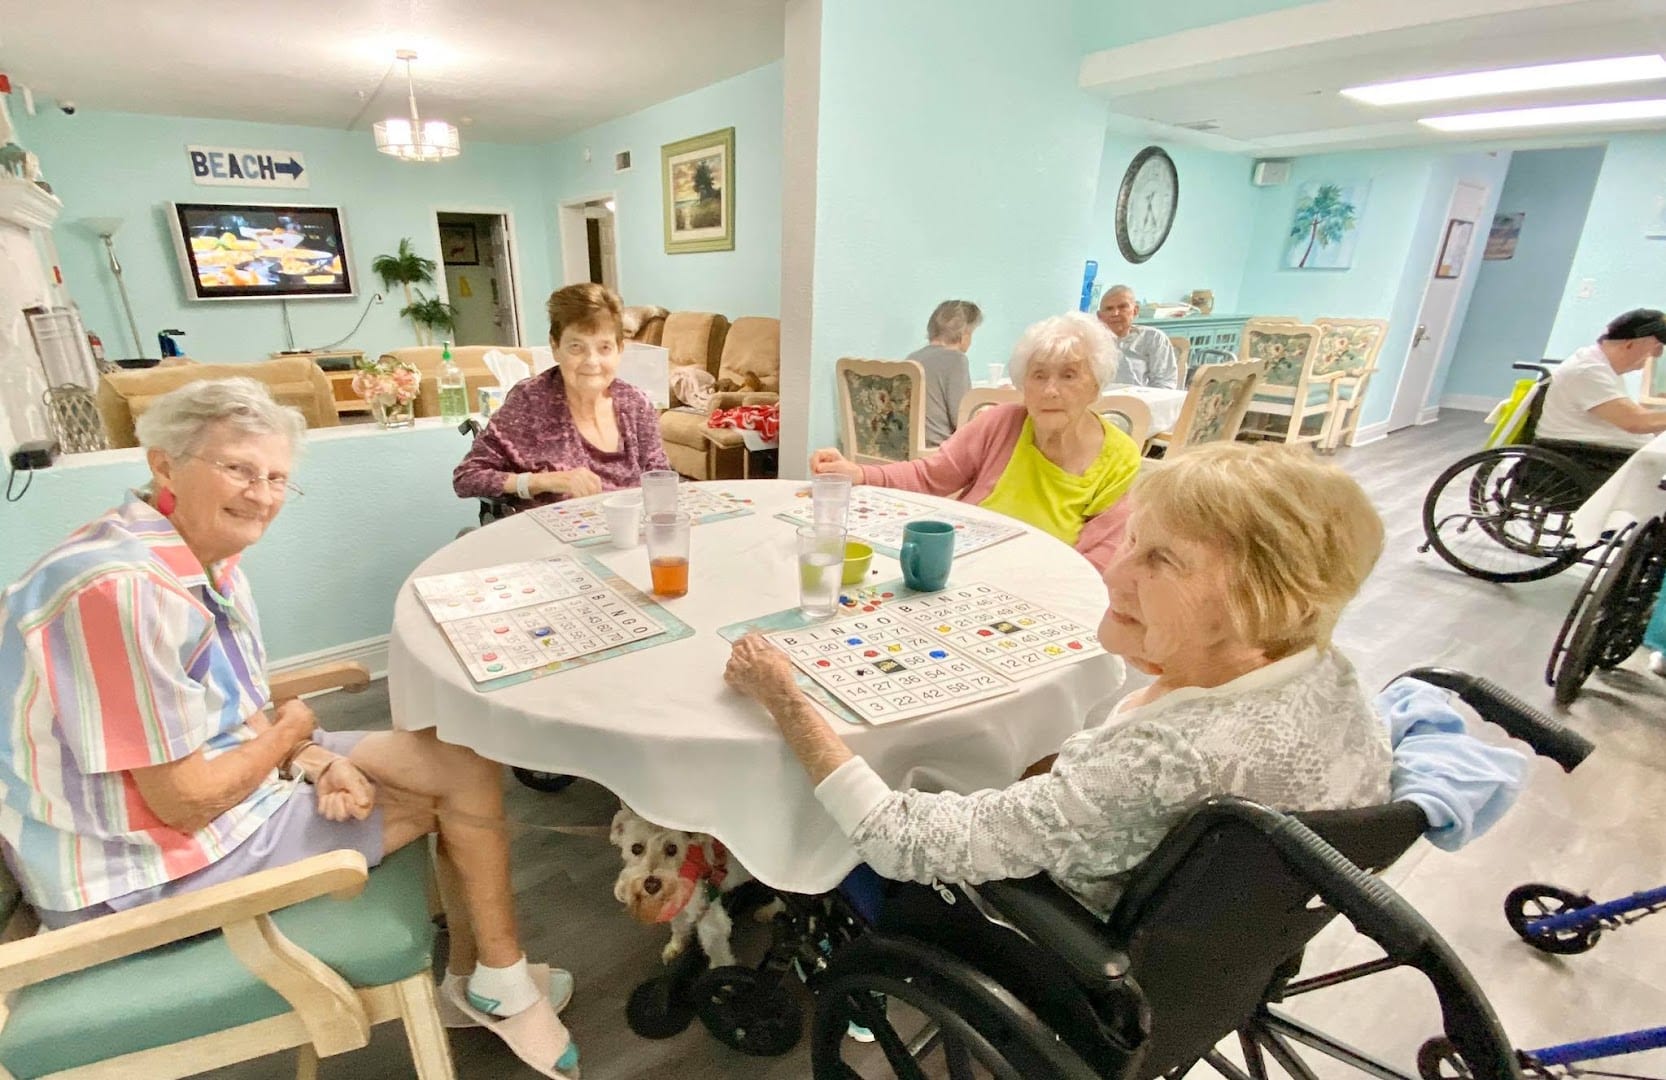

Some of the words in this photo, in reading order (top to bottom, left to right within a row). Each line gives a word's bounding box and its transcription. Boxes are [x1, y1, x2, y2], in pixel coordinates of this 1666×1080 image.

[190, 151, 275, 180] BEACH
[819, 643, 839, 652] 30
[891, 626, 910, 635] 71
[836, 655, 853, 664] 17
[907, 638, 928, 647] 74
[956, 635, 968, 643] 7
[976, 647, 996, 656] 14
[1000, 659, 1022, 669] 12
[1022, 652, 1040, 663] 27
[832, 674, 846, 682] 2
[847, 687, 868, 697] 14
[872, 681, 892, 691] 27
[898, 675, 921, 686] 36
[924, 669, 946, 679] 54
[951, 662, 972, 673] 61
[869, 702, 884, 712] 3
[893, 695, 917, 706] 22
[923, 689, 944, 700] 42
[946, 682, 970, 693] 58
[970, 675, 996, 686] 72
